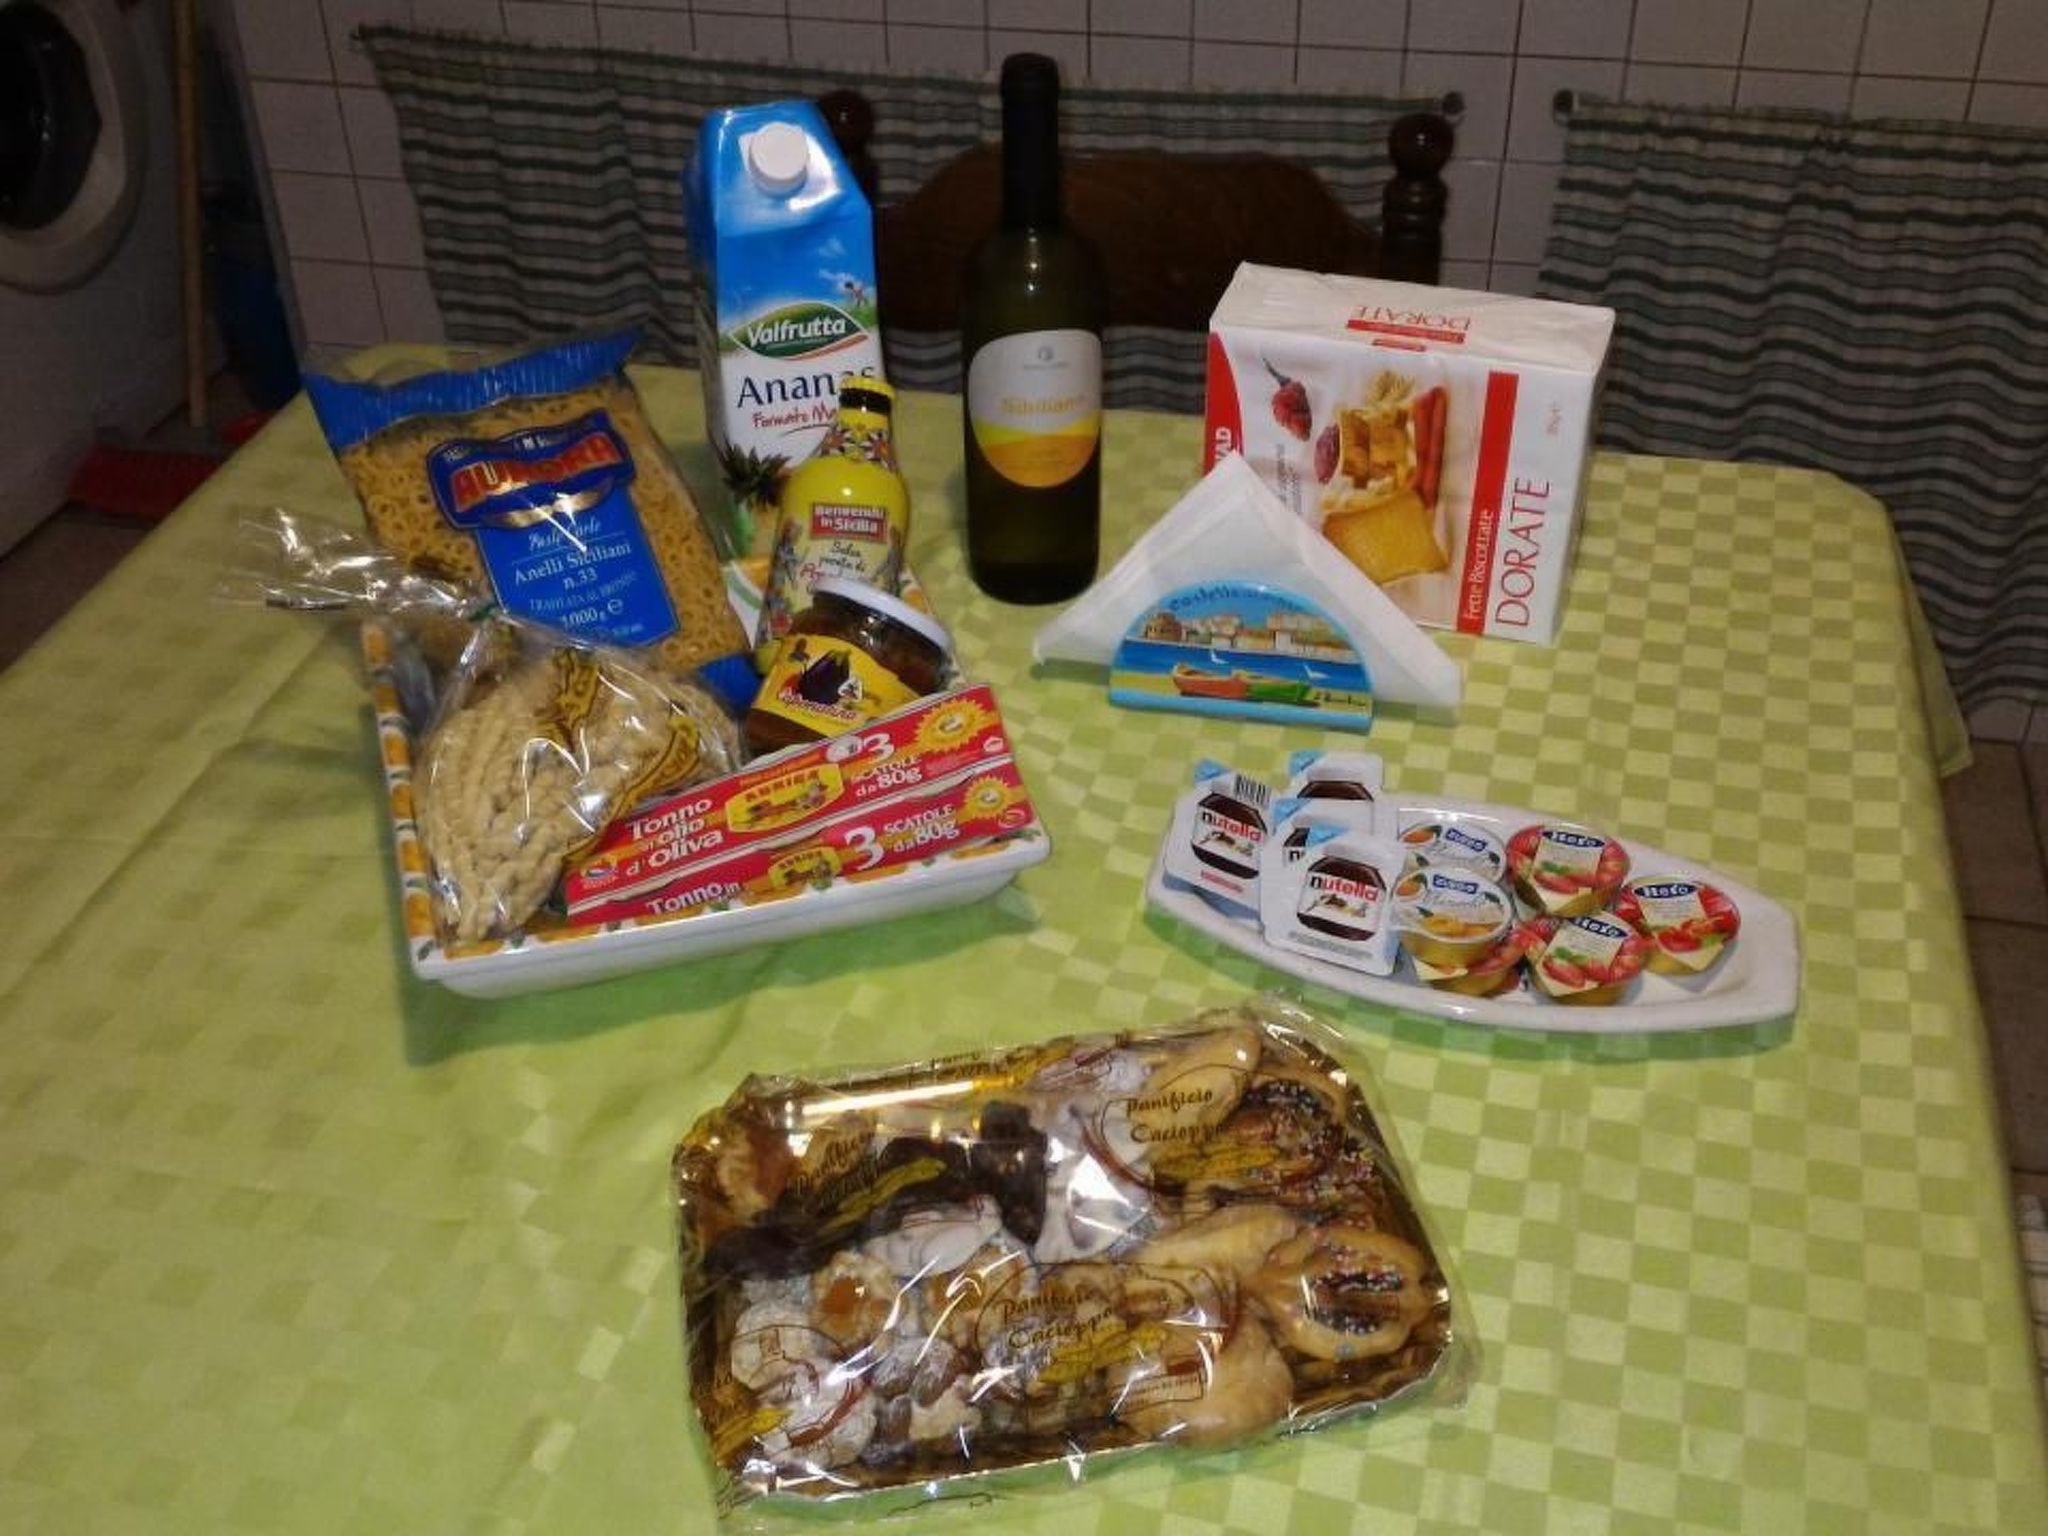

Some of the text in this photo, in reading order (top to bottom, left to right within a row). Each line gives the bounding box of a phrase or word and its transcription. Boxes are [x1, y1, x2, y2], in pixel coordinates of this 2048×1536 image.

[748, 315, 846, 348] Valfrutta
[1356, 305, 1471, 331] DORATE
[834, 516, 878, 533] Sicilia
[515, 542, 631, 586] Anelli Siciliani
[1495, 477, 1550, 627] DORATE
[563, 567, 597, 589] n.33
[561, 609, 598, 629] 1000
[863, 733, 895, 759] 3
[856, 767, 922, 797] da 80g
[625, 799, 712, 839] Tonno
[658, 819, 705, 843] olio
[883, 804, 957, 835] SCATOLE
[1202, 810, 1263, 843] nutella
[844, 825, 884, 870] 3
[914, 821, 960, 847] 80g
[646, 882, 723, 915] Tonno
[1310, 875, 1379, 901] nutella
[1642, 883, 1690, 899] Hero
[1127, 1089, 1212, 1117] Panificio
